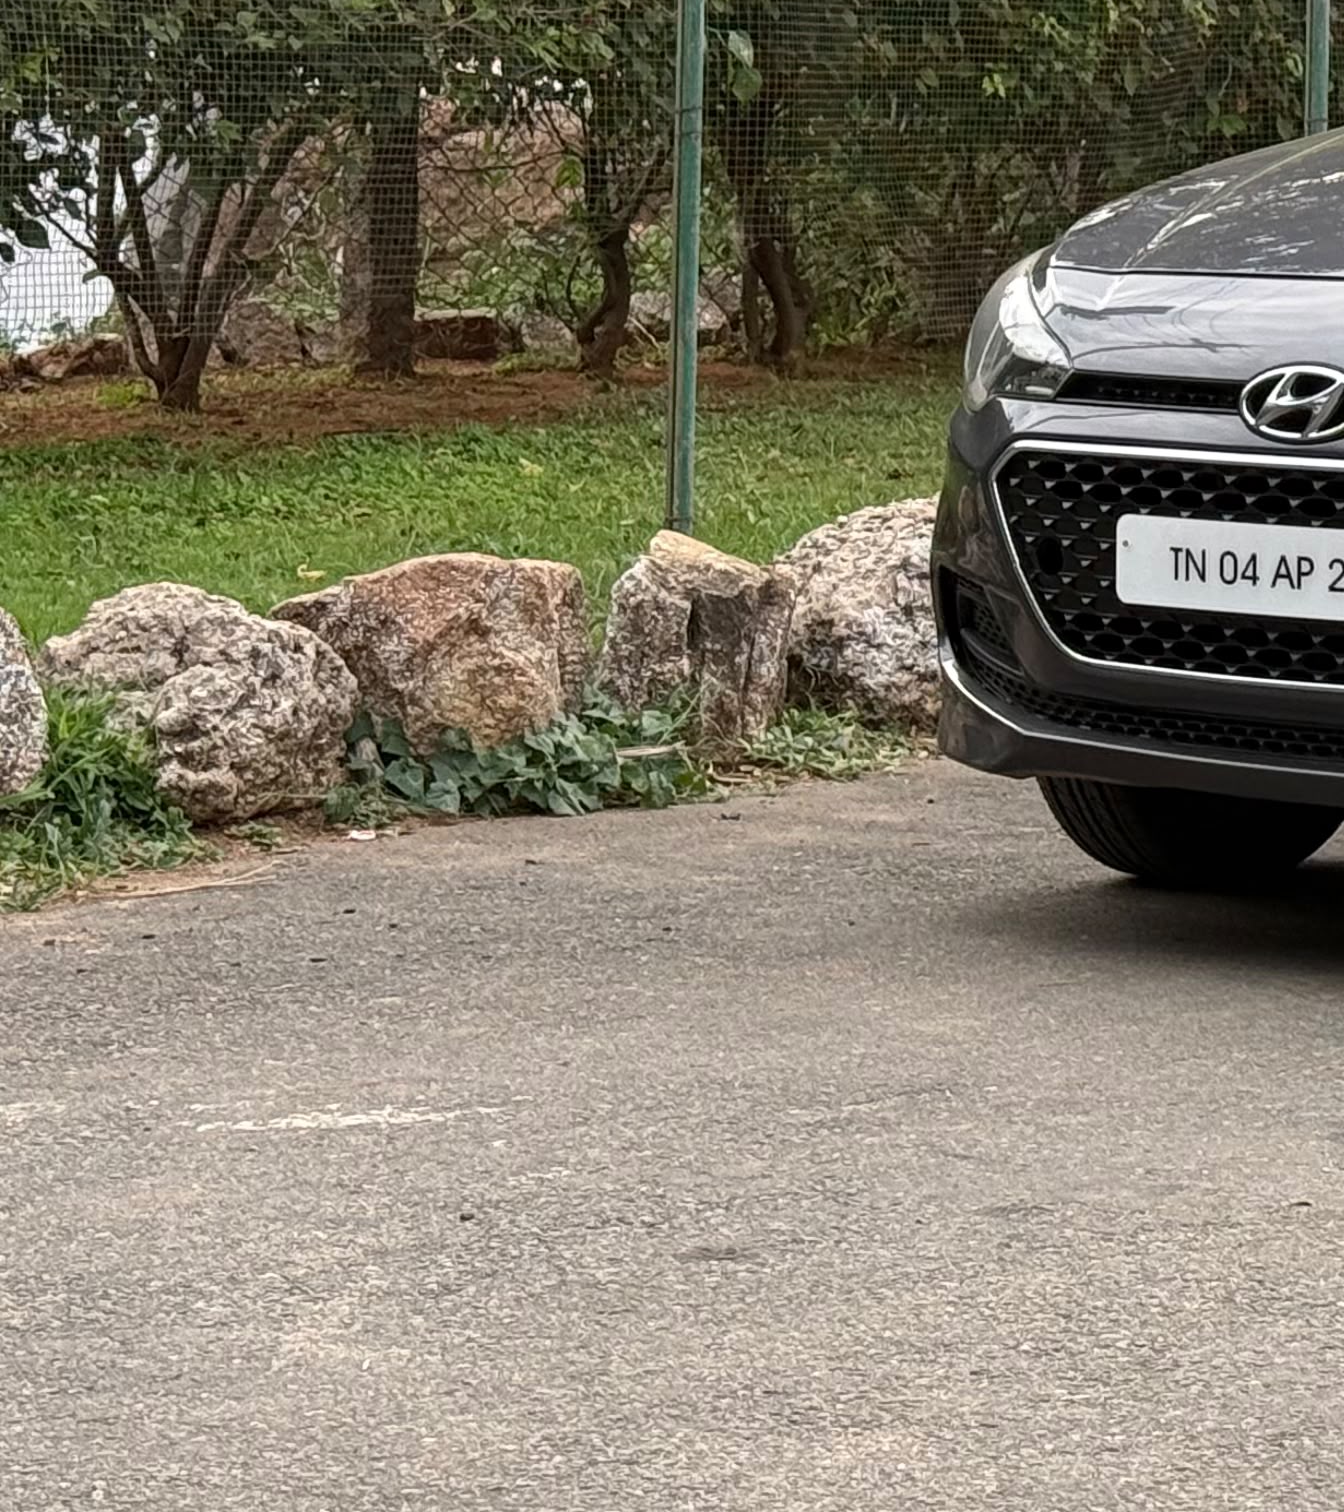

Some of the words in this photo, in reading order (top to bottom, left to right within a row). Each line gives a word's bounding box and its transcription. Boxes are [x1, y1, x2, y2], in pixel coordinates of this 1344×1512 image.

[1169, 545, 1207, 584] TN
[1218, 550, 1260, 587] 04
[1270, 554, 1316, 590] AP
